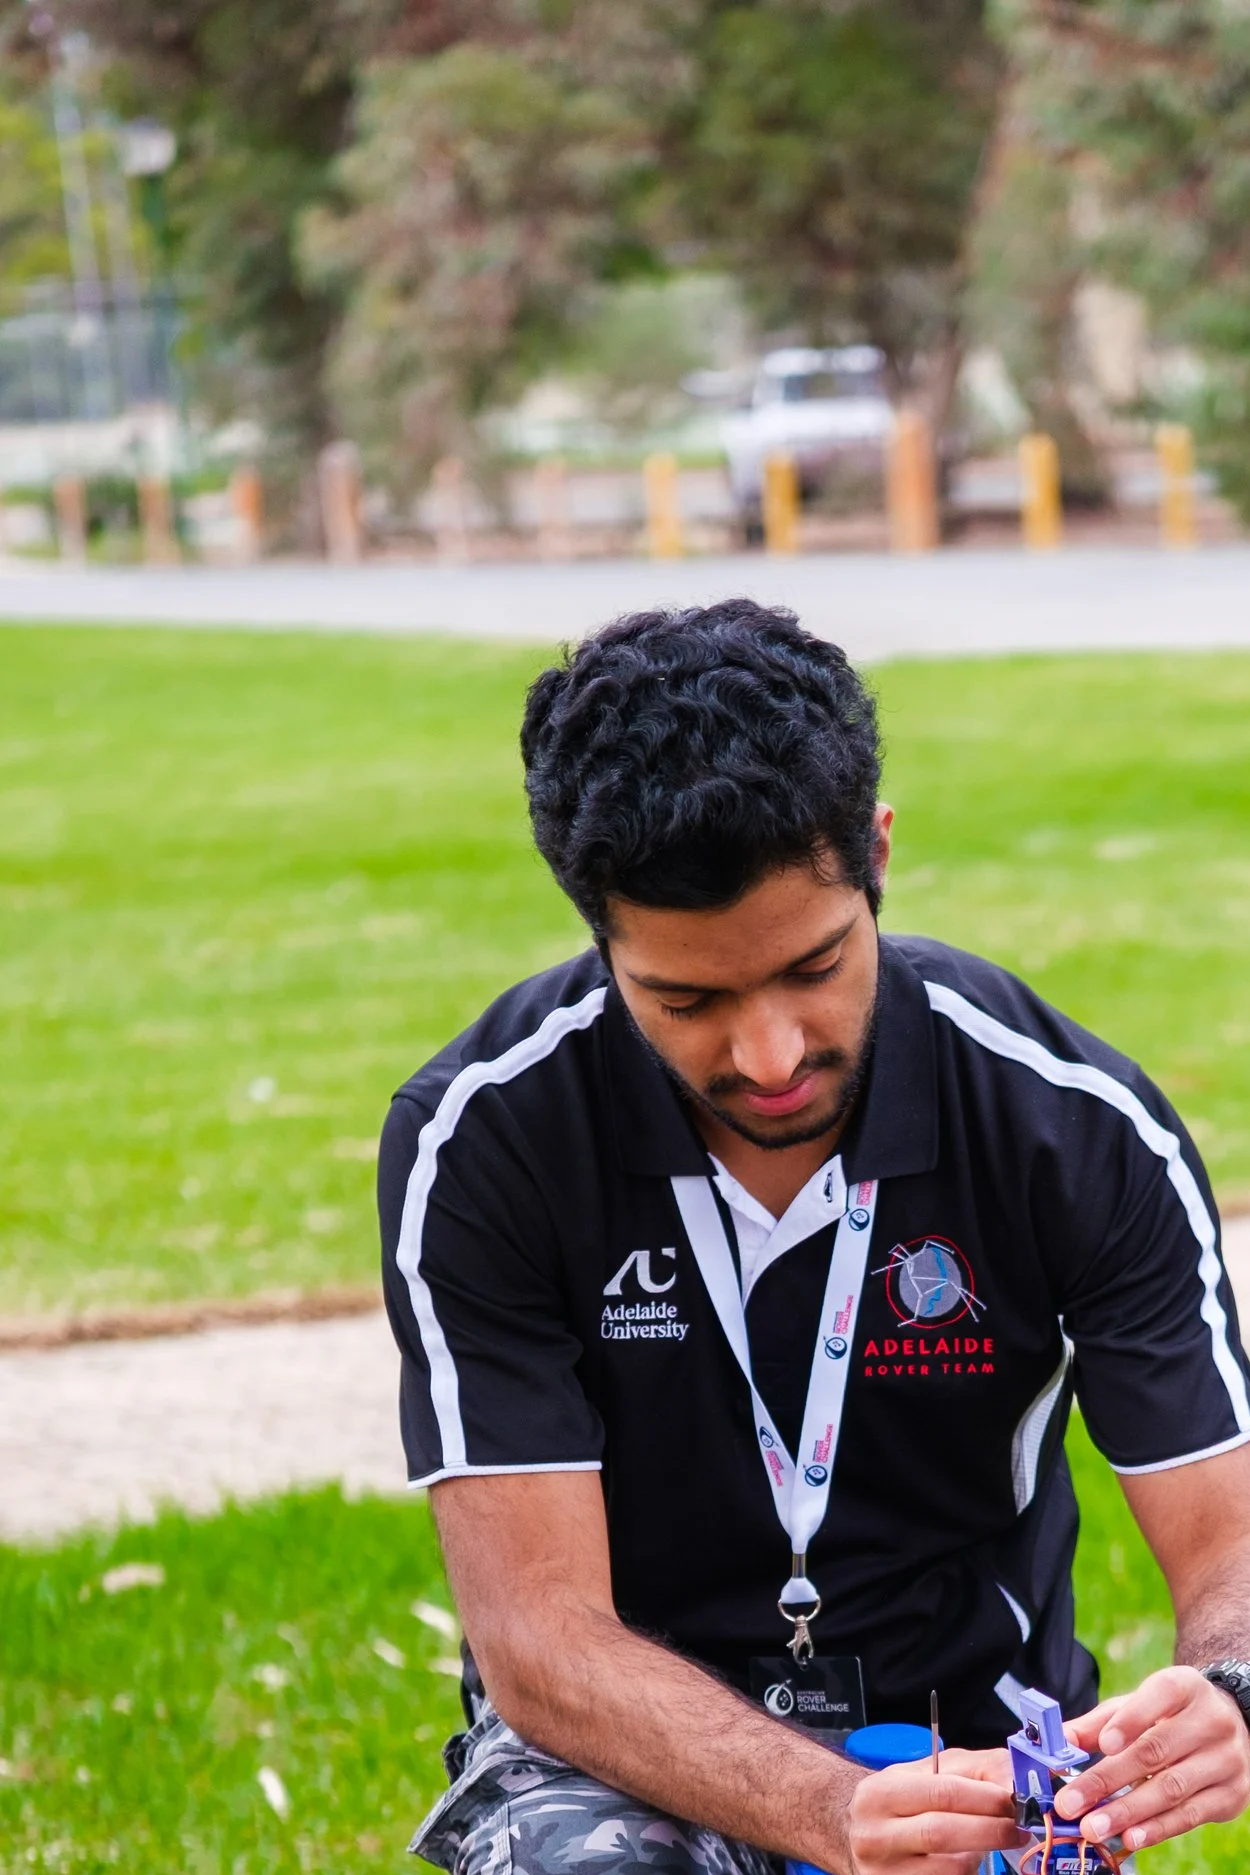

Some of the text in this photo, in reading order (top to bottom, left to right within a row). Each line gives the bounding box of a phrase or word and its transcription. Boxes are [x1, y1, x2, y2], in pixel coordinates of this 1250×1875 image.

[602, 1301, 677, 1320] Adelaide
[601, 1320, 690, 1341] University
[864, 1337, 994, 1357] ADELAIDE
[864, 1363, 995, 1377] ROVER TEAM
[796, 1695, 826, 1704] ROVER
[797, 1703, 850, 1712] CHALLENGE
